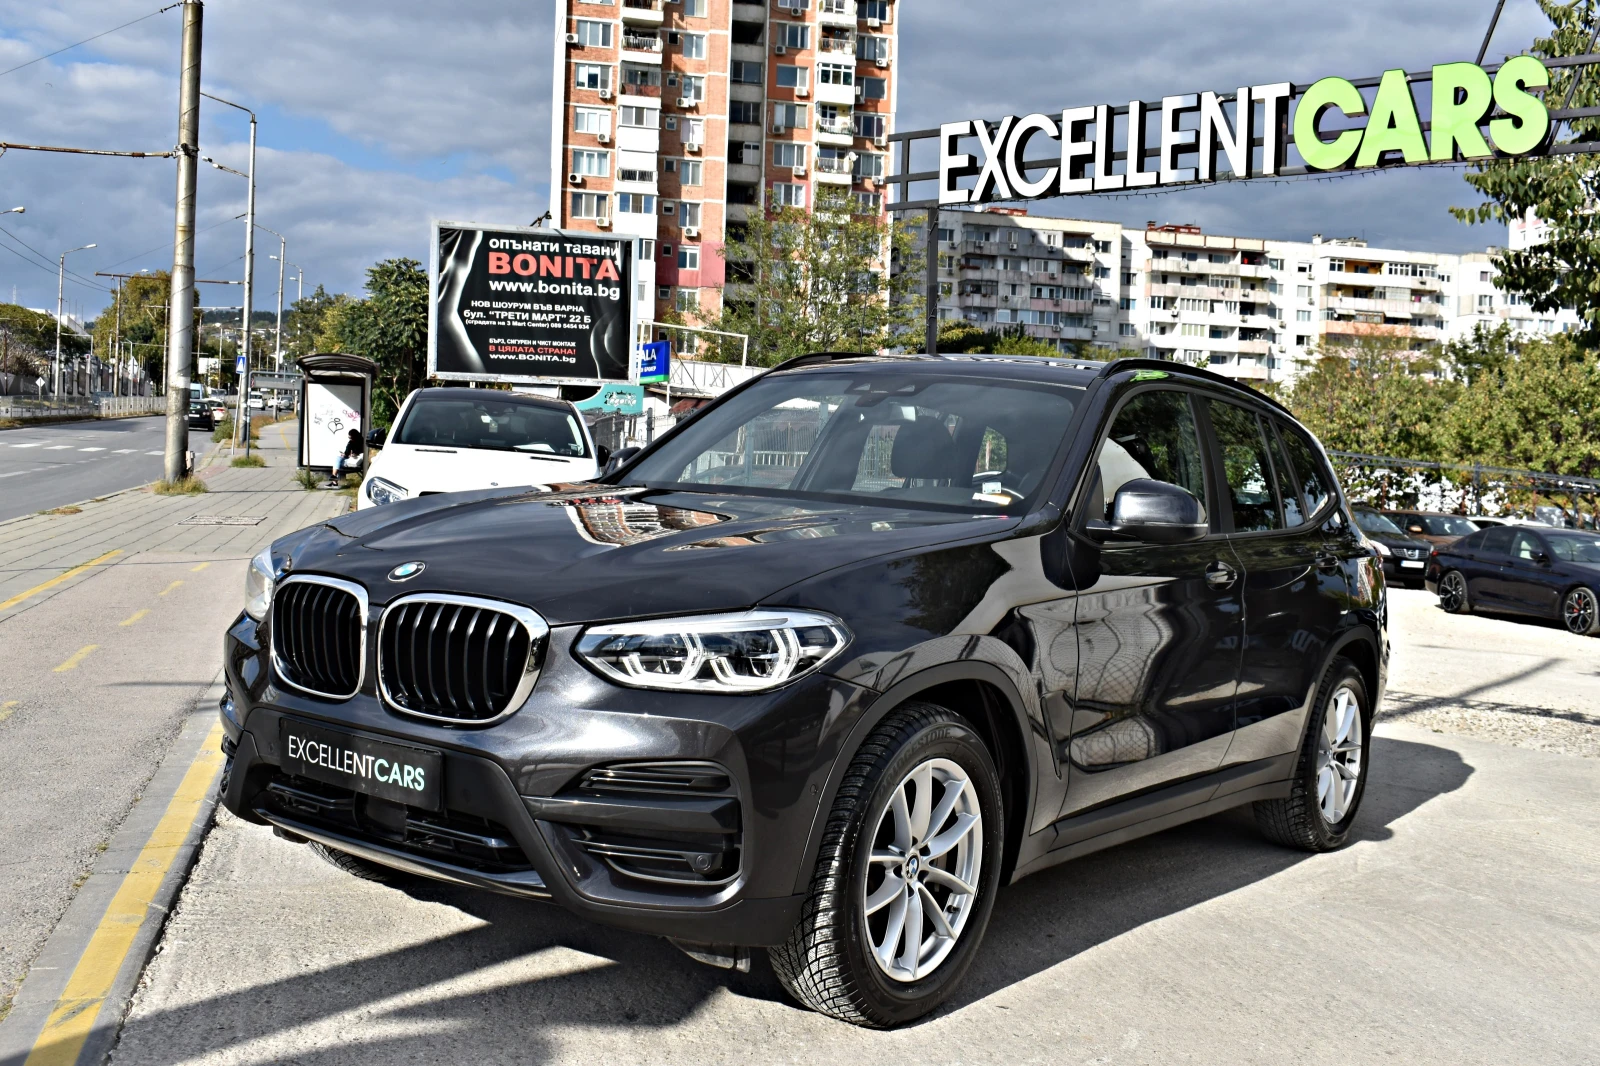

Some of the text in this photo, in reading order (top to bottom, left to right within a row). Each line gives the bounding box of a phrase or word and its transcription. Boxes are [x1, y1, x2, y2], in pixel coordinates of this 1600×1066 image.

[938, 54, 1550, 204] EXCELLENTCARS
[488, 237, 619, 256] опънати тавани
[488, 251, 620, 281] BONITA
[488, 279, 620, 301] www.bonita.bg
[471, 300, 585, 313] НОВ ШОУРУМ ВЪВ ВАРНА
[463, 309, 486, 320] бул.
[569, 315, 581, 323] 22
[583, 315, 592, 324] Б
[527, 321, 550, 329] Center)
[497, 345, 536, 354] ЦЯЛАТА
[537, 346, 577, 356] СТРАНА!
[507, 338, 532, 346] СИГУРЕН
[552, 340, 576, 348] МОНТАЖ
[489, 353, 577, 364] www.BONITA.bg
[288, 735, 426, 792] EXCELLENTCARS
